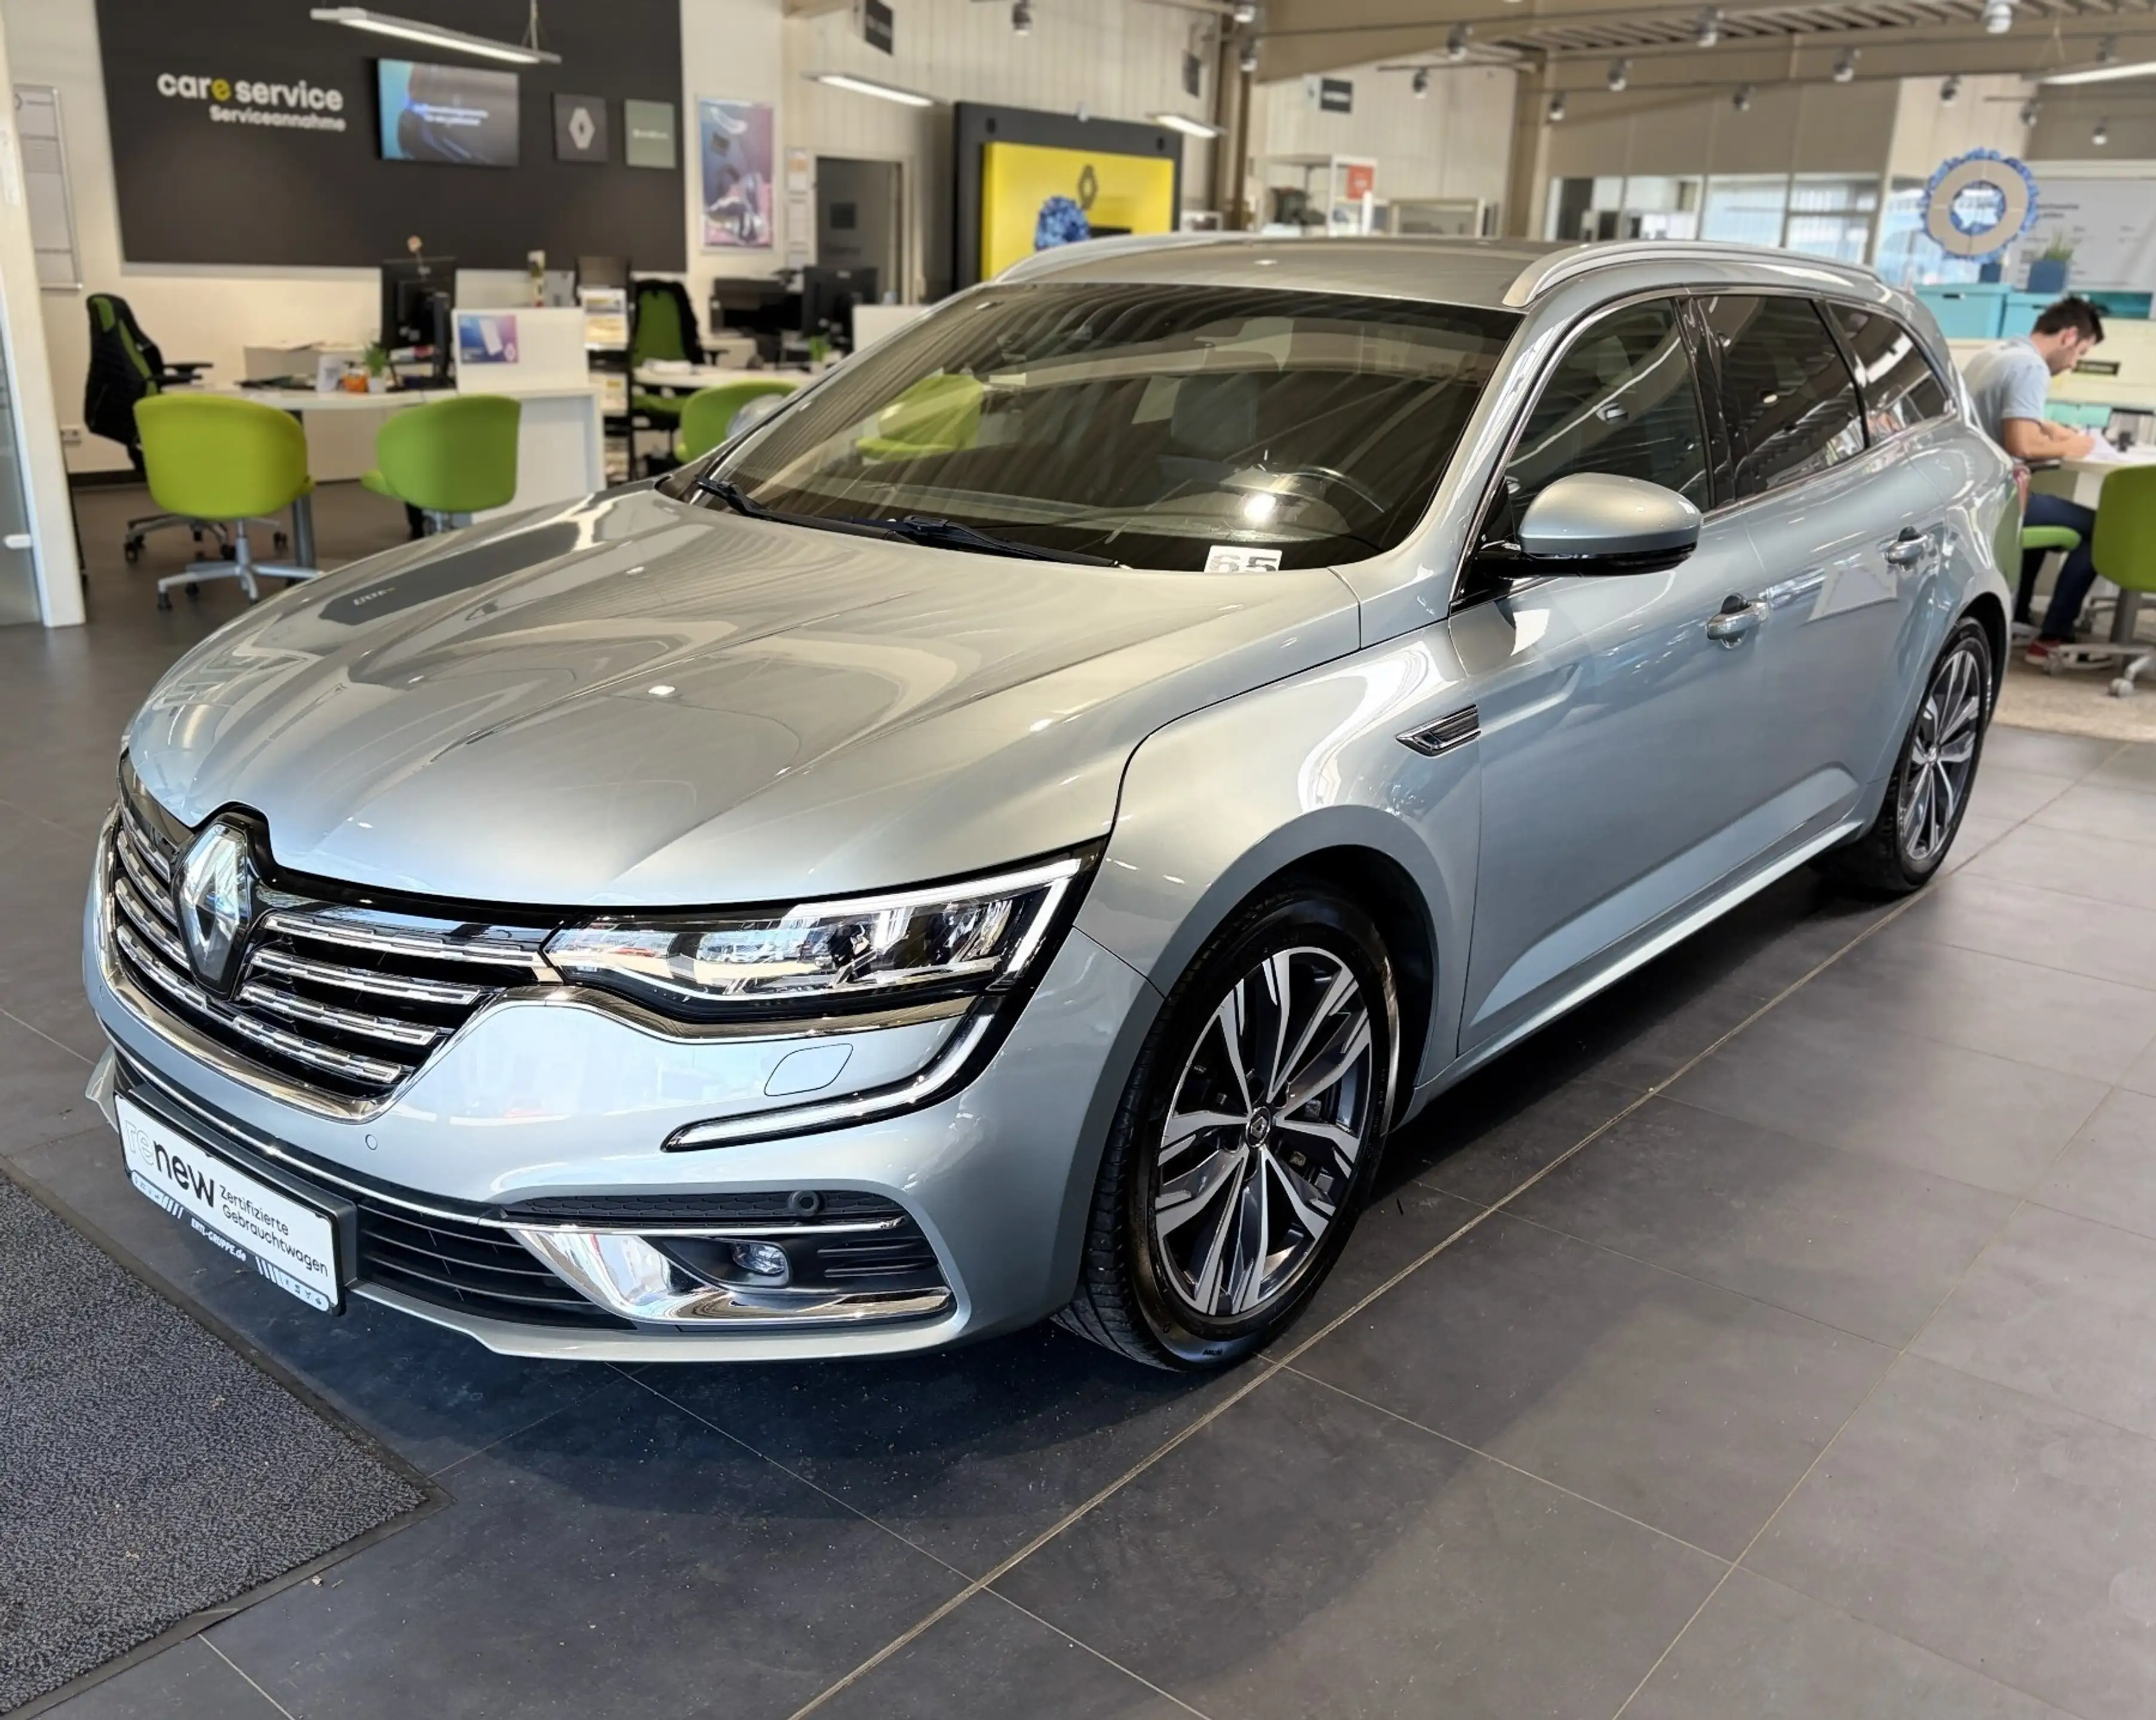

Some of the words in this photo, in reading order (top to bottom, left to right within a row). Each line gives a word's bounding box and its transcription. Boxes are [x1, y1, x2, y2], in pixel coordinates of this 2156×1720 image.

[157, 72, 231, 101] care
[235, 79, 343, 111] service
[208, 104, 346, 132] Serviceannahme
[219, 1184, 289, 1236] Zertifizierte
[222, 1205, 329, 1277] Gebrauchtwagen
